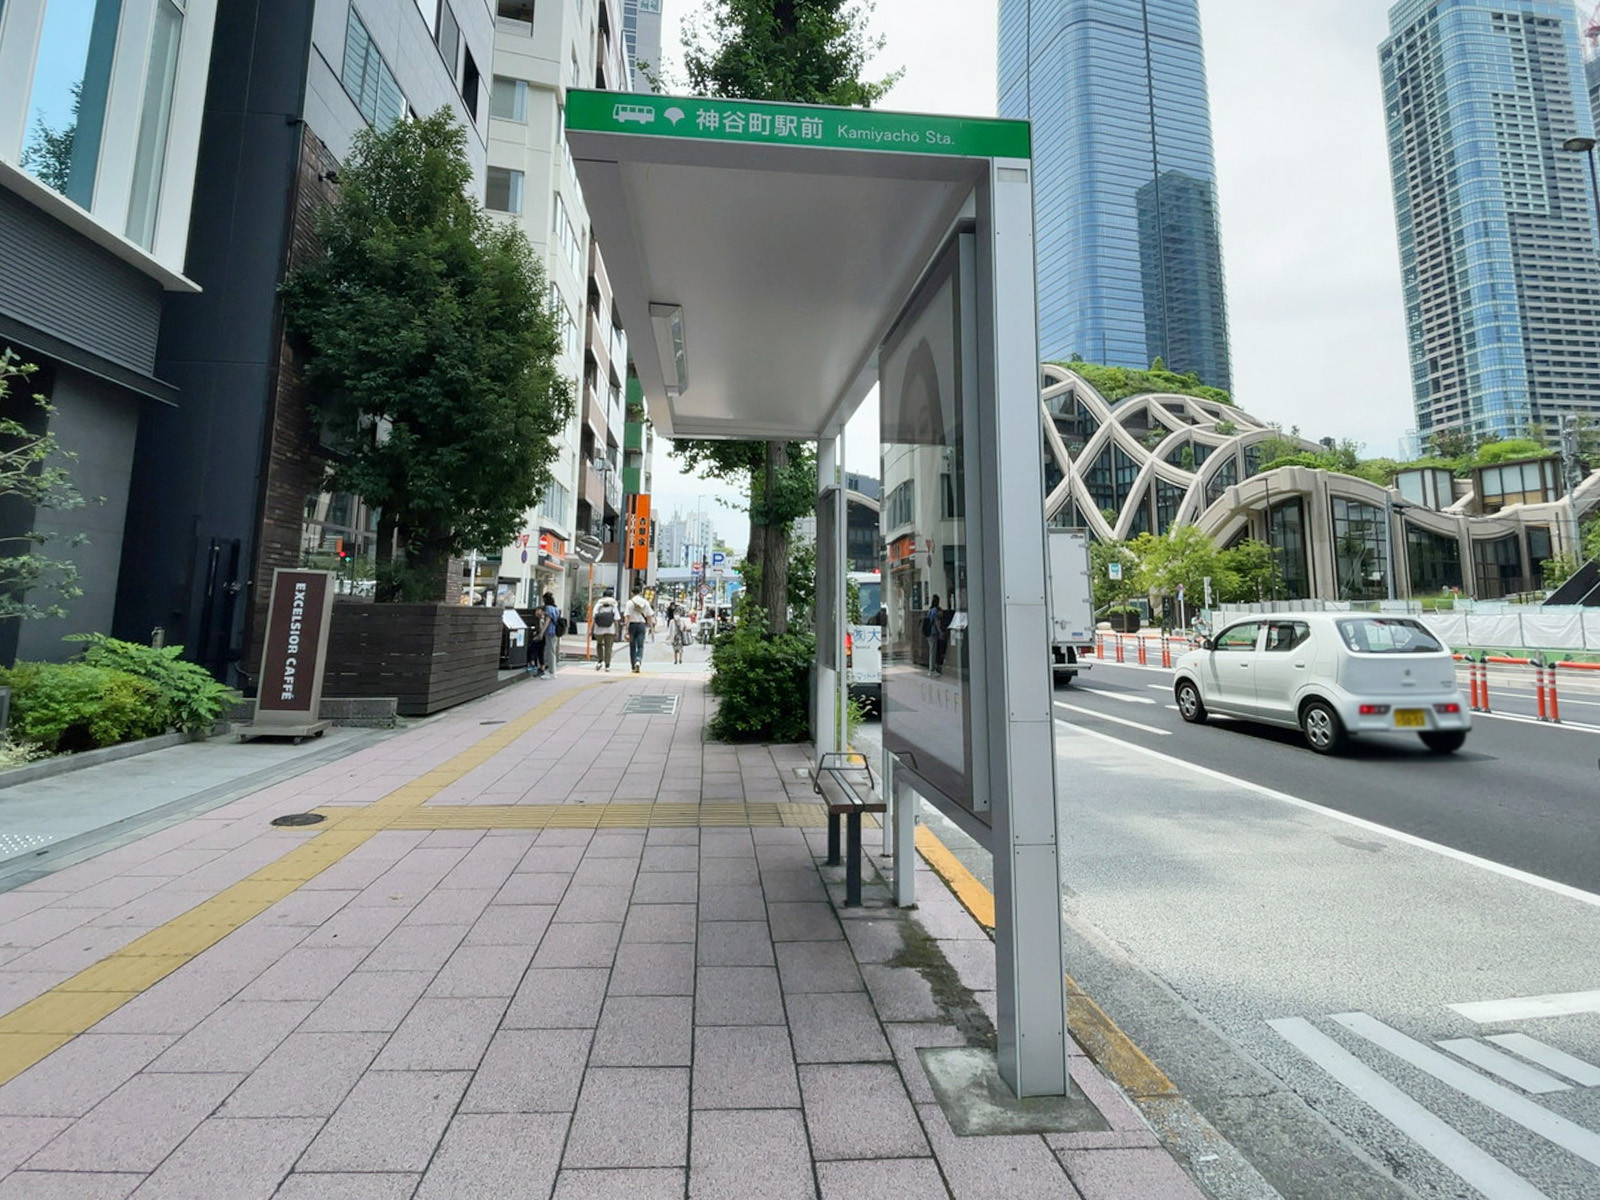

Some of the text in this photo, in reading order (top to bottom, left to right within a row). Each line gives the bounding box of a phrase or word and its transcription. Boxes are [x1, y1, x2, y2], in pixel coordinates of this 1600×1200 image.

[696, 108, 824, 139] 神谷町駅前
[837, 124, 955, 145] Kamiyachō Sta.
[712, 553, 725, 566] P
[281, 582, 307, 700] EXCELSIOR CAFFÉ
